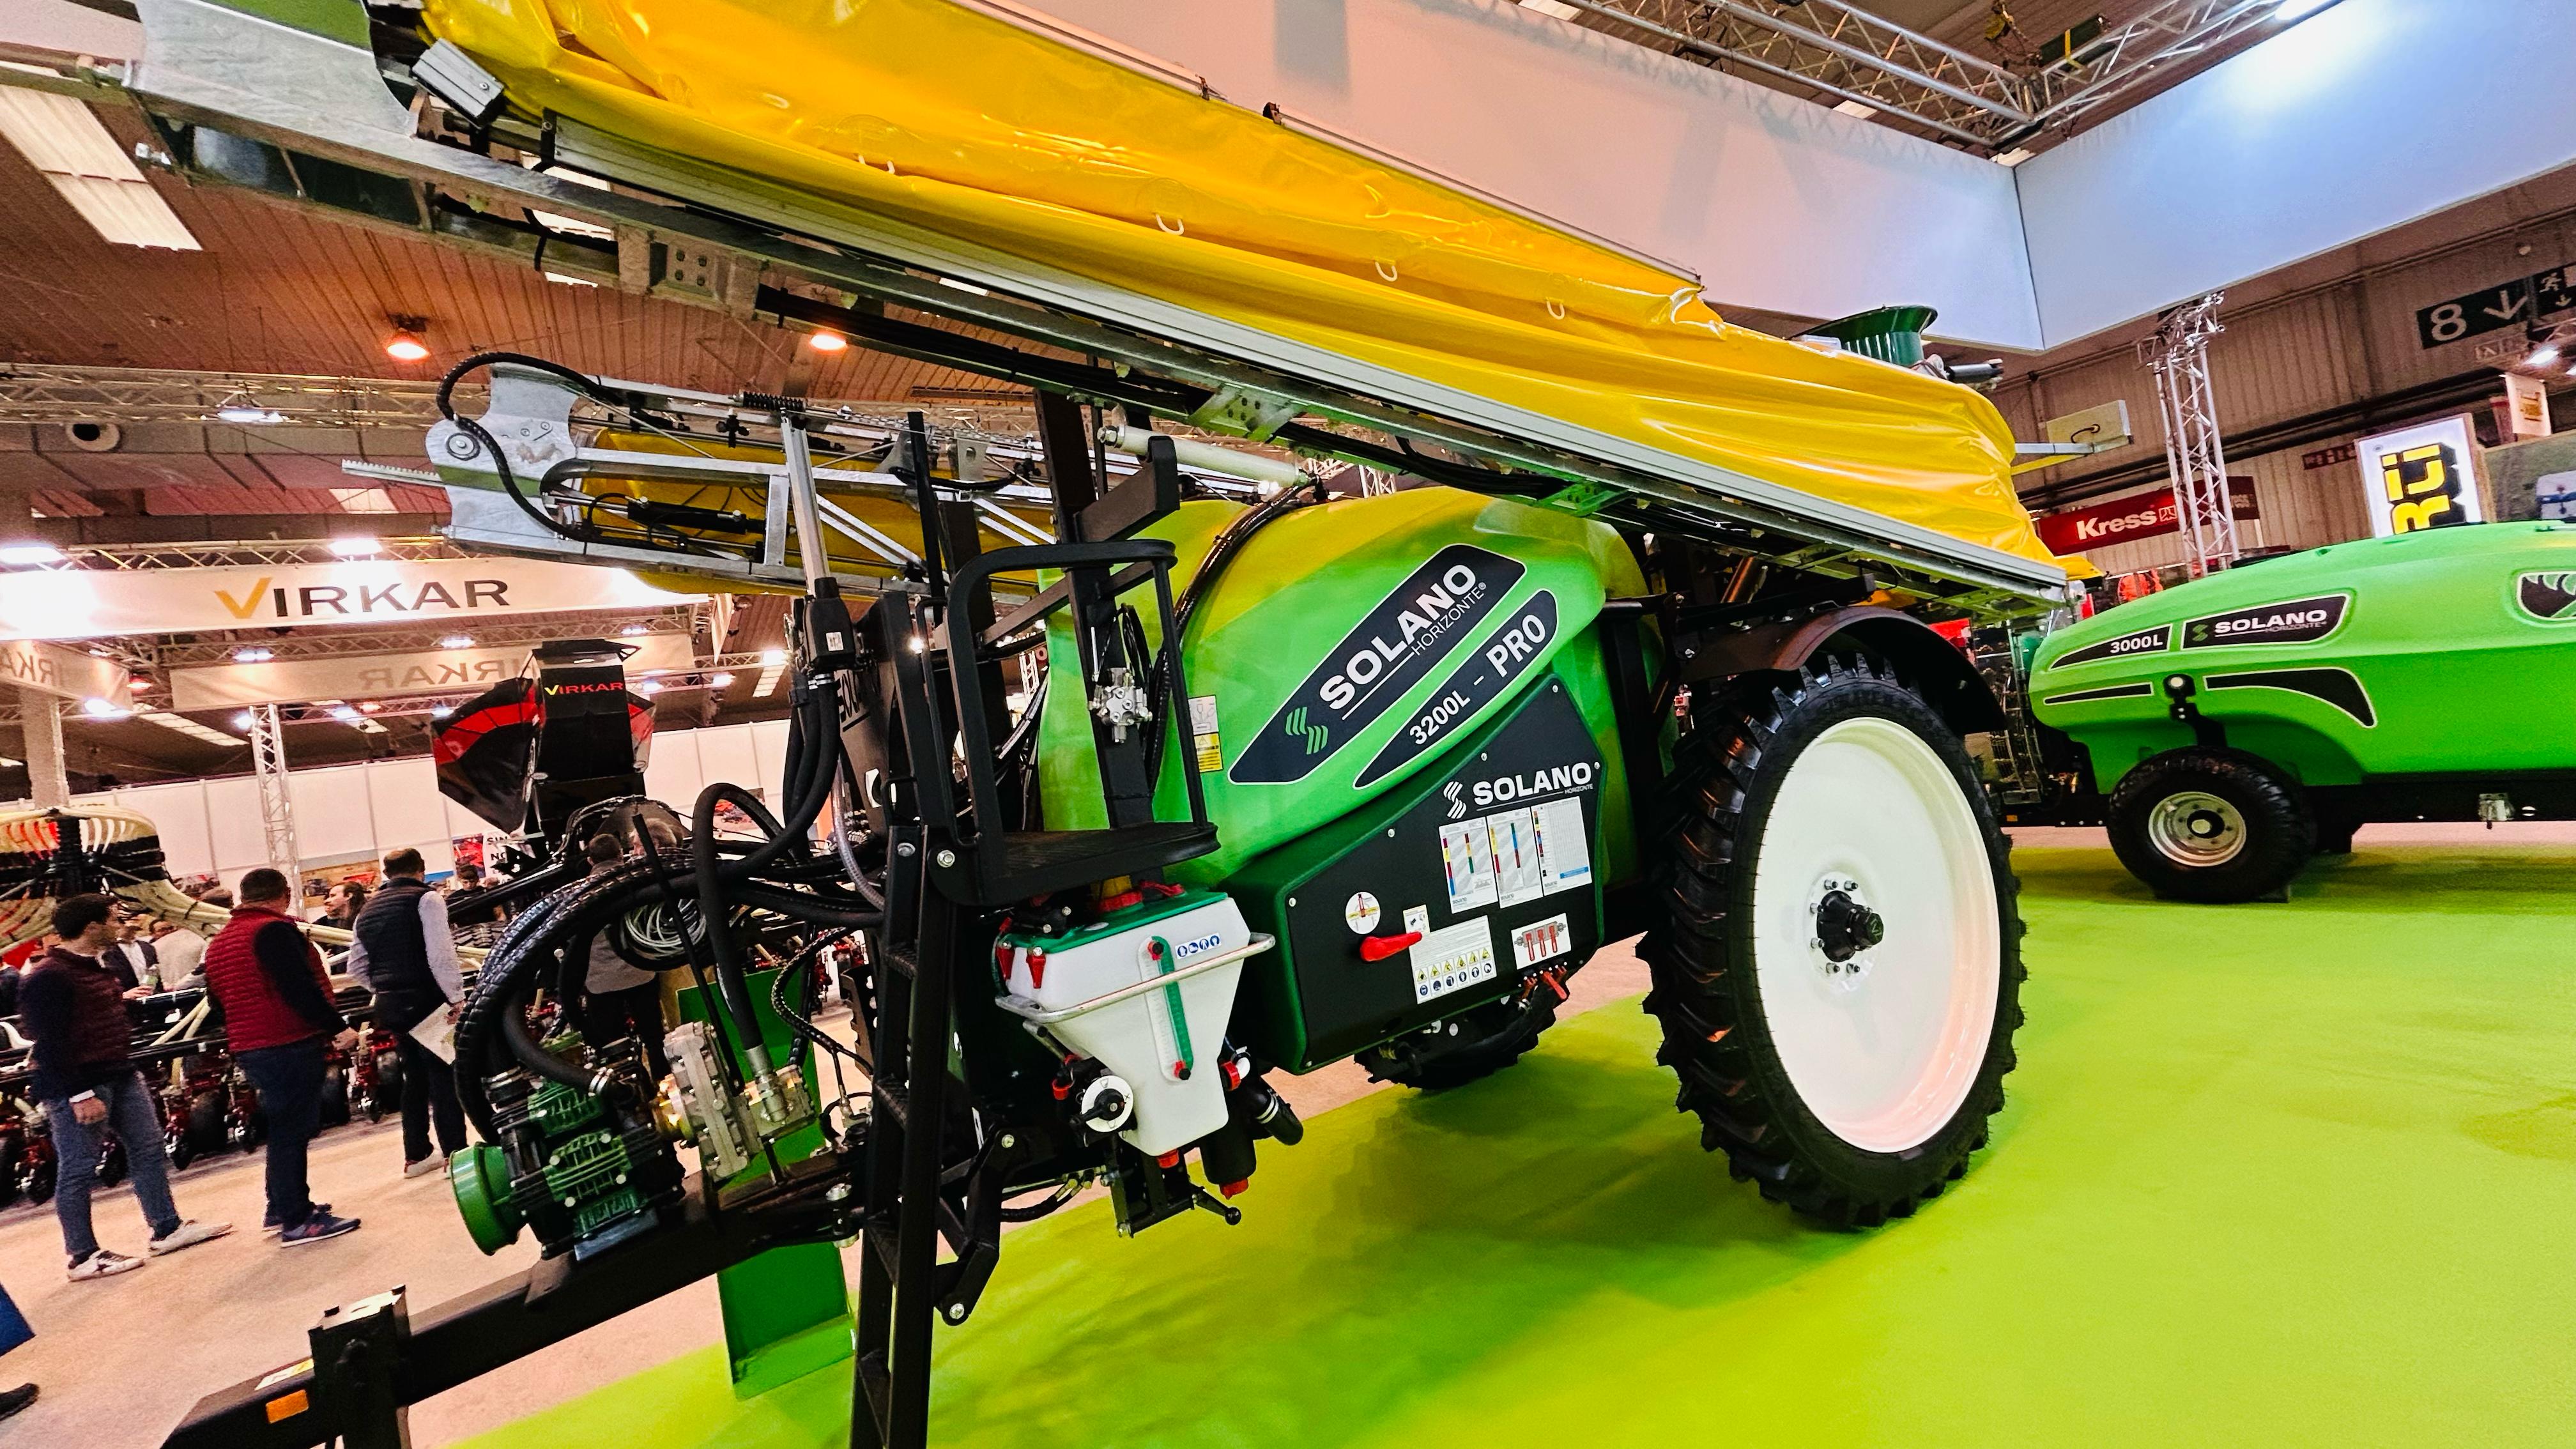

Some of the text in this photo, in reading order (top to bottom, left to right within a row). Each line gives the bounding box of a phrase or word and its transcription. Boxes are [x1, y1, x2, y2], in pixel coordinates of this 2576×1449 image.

[2430, 303, 2467, 341] 8
[2076, 510, 2158, 540] Kress
[214, 577, 510, 619] VIRKAR
[1320, 565, 1476, 710] SOLANO
[2214, 610, 2327, 634] SOLANO
[2110, 634, 2163, 654] 3000L
[544, 682, 624, 696] VIRKAR
[1409, 691, 1470, 744] 3200L
[1486, 614, 1546, 678] PRO
[1473, 762, 1591, 806] SOLANO
[1565, 783, 1593, 794] HORIZONTE
